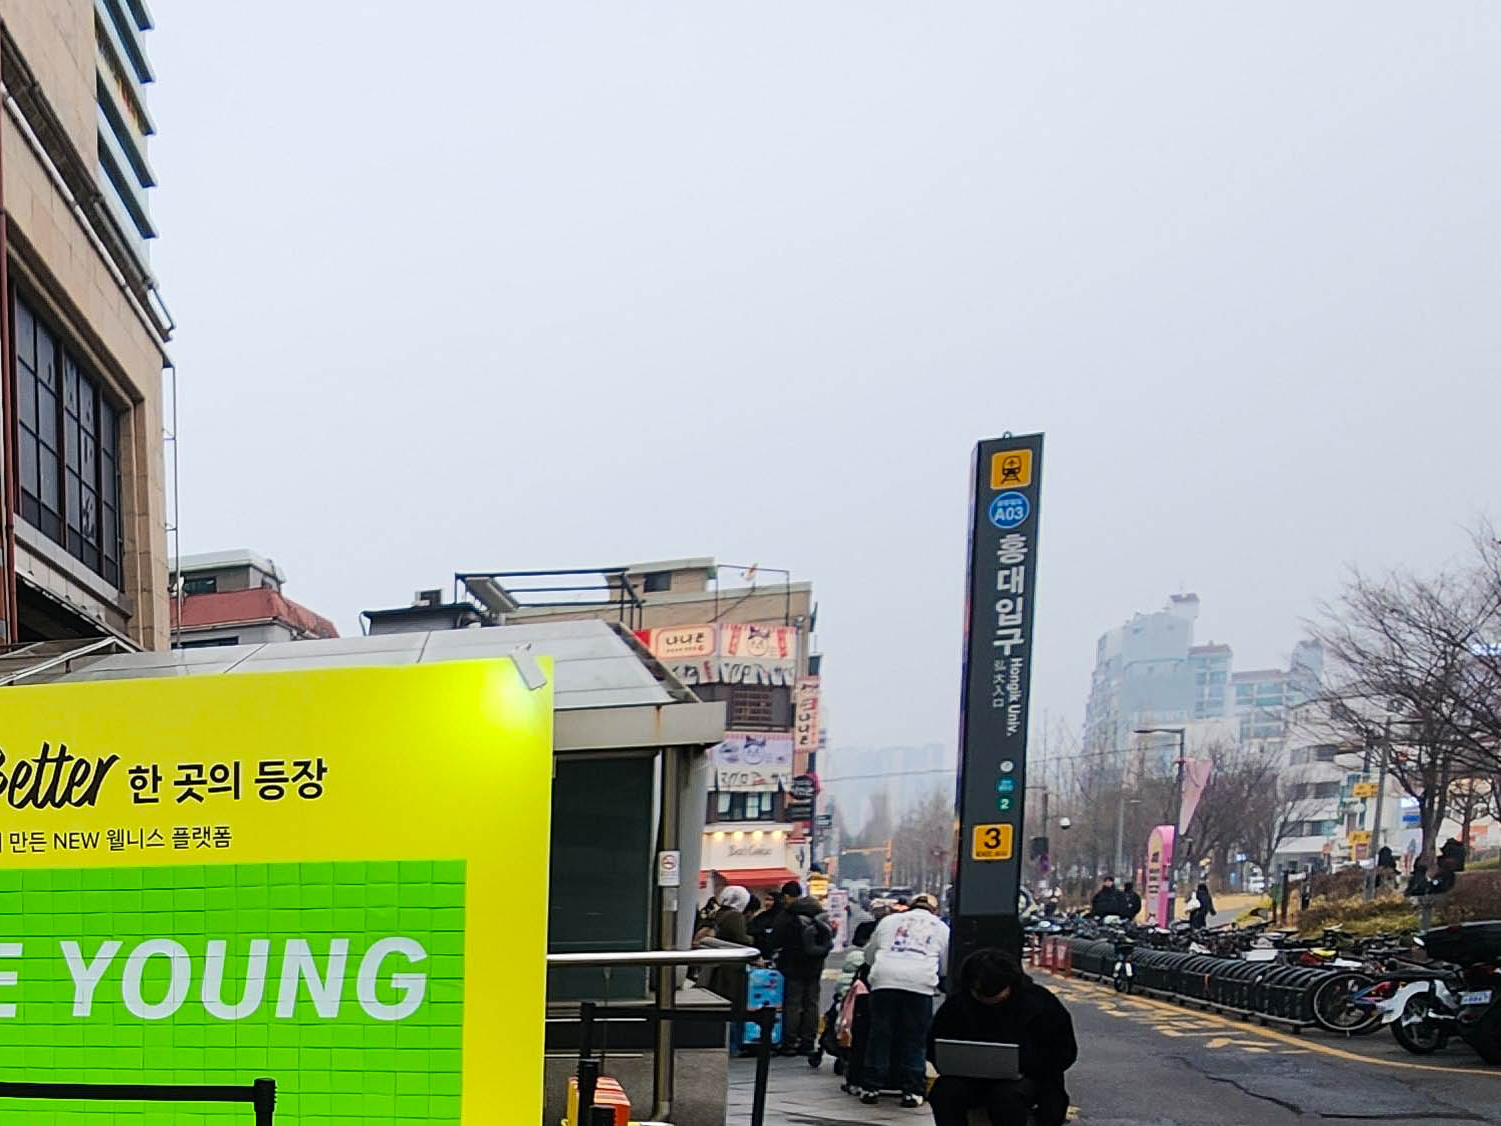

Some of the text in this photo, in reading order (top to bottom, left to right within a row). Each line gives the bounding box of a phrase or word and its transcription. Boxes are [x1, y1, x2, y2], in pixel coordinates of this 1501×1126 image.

[994, 506, 1024, 520] A03
[993, 533, 1028, 656] 홍대입구
[1006, 657, 1023, 737] Hongik Univ.
[129, 763, 162, 804] 한
[174, 760, 240, 802] 곳의
[255, 758, 328, 801] 등장
[1000, 799, 1010, 809] 2
[10, 831, 47, 856] 만든
[54, 832, 99, 851] NEW
[106, 828, 165, 852] 웰니스
[172, 827, 233, 850] 플랫폼
[984, 828, 1001, 849] 3
[60, 936, 427, 1020] YOUNG
